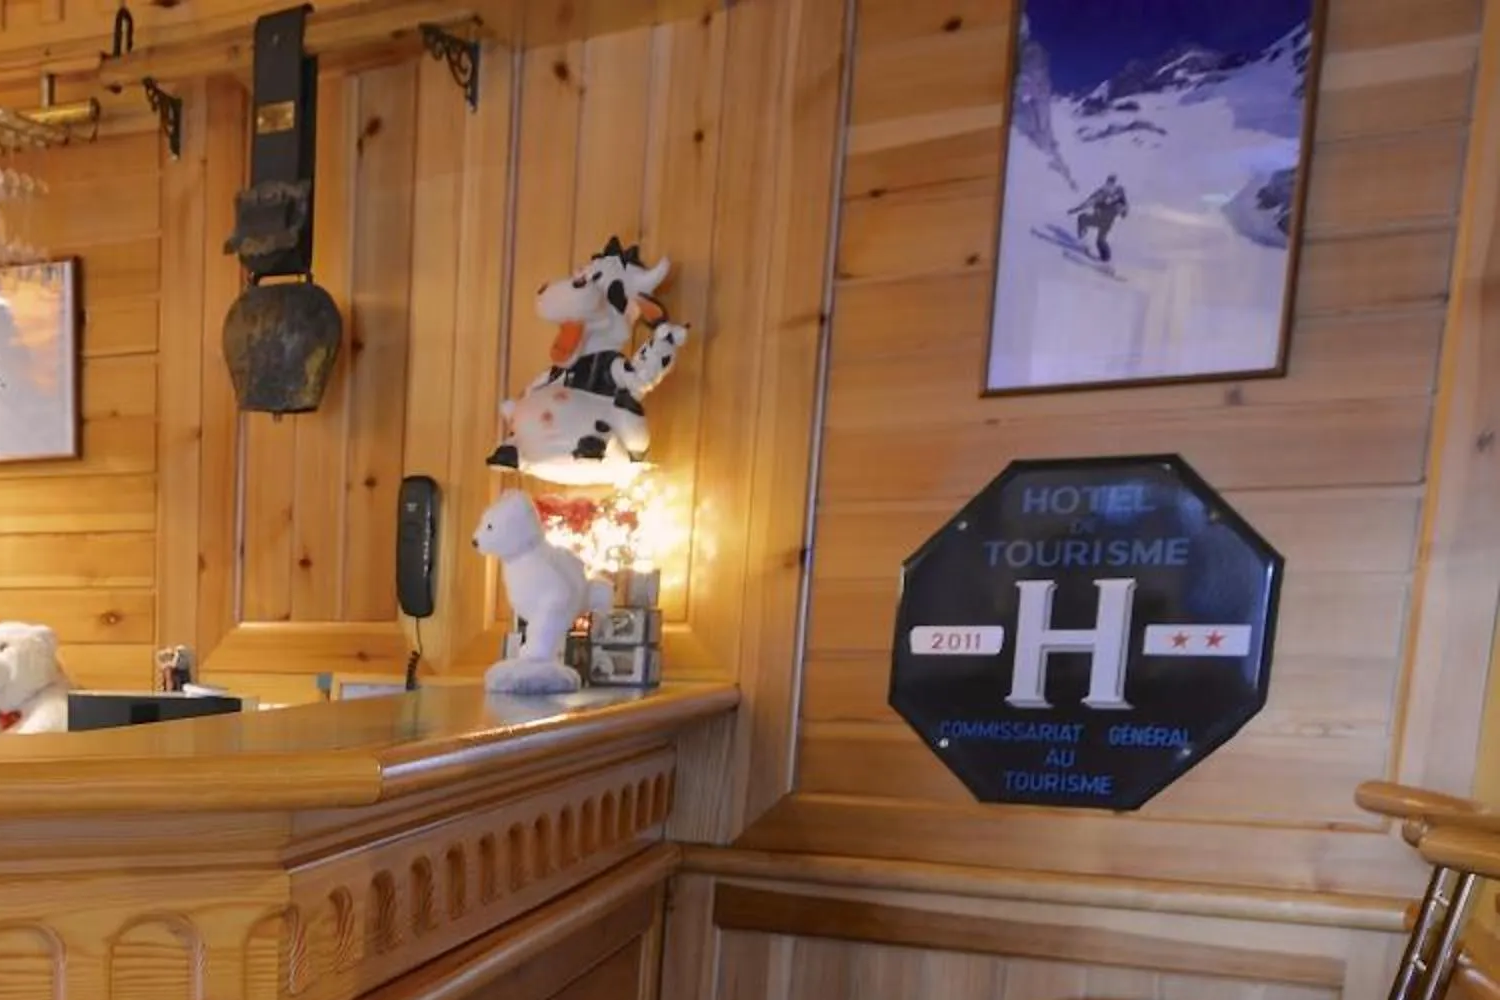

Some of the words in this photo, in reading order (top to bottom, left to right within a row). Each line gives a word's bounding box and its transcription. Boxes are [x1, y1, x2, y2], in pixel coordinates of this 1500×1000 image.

[983, 537, 1190, 568] TOURISME
[931, 632, 982, 650] 2011
[1004, 578, 1138, 710] H
[940, 720, 1084, 744] COMMISSARIAT
[1109, 723, 1191, 749] GÉNÉRAL
[1045, 749, 1075, 768] AU
[1004, 771, 1114, 796] TOURISME
